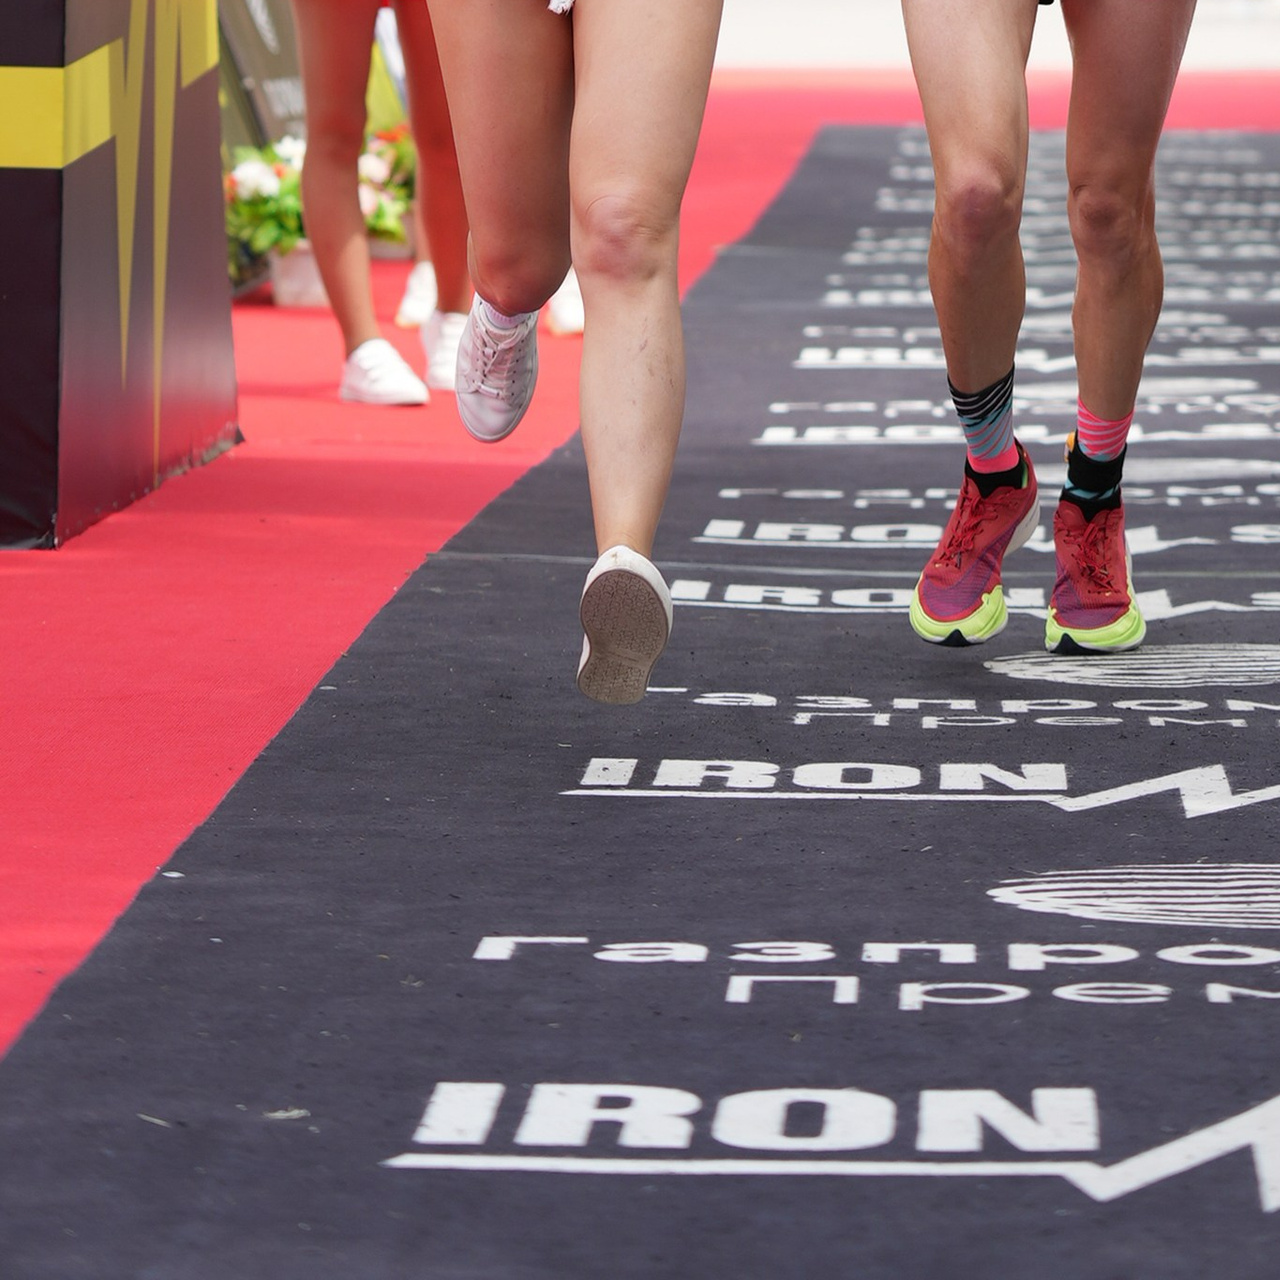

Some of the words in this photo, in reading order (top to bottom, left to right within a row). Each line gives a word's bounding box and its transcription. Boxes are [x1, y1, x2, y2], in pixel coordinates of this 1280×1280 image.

[702, 518, 1047, 542] IRO
[580, 757, 1069, 792] IRON
[413, 1081, 1100, 1152] IRON
